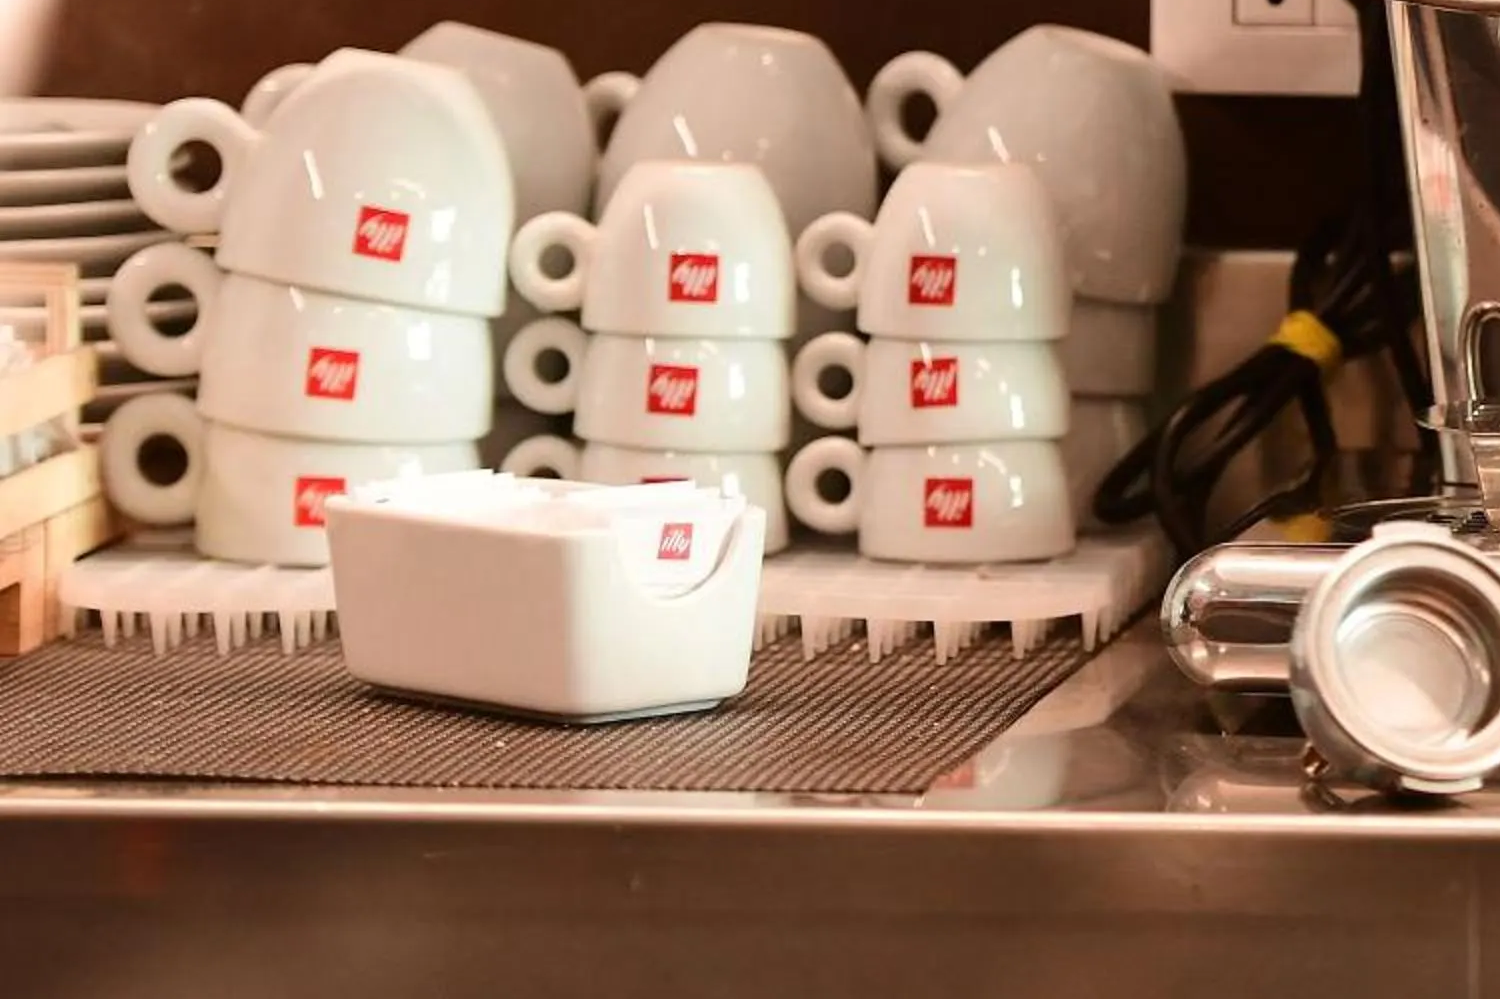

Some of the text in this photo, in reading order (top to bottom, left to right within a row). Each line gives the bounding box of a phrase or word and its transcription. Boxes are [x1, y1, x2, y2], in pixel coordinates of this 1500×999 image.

[359, 213, 405, 254] illy
[672, 258, 716, 298] illy
[911, 262, 953, 299] illy
[310, 354, 355, 393] illy
[650, 371, 695, 410] illy
[915, 366, 955, 402] illy
[928, 484, 970, 521] illy
[661, 527, 690, 555] illy
